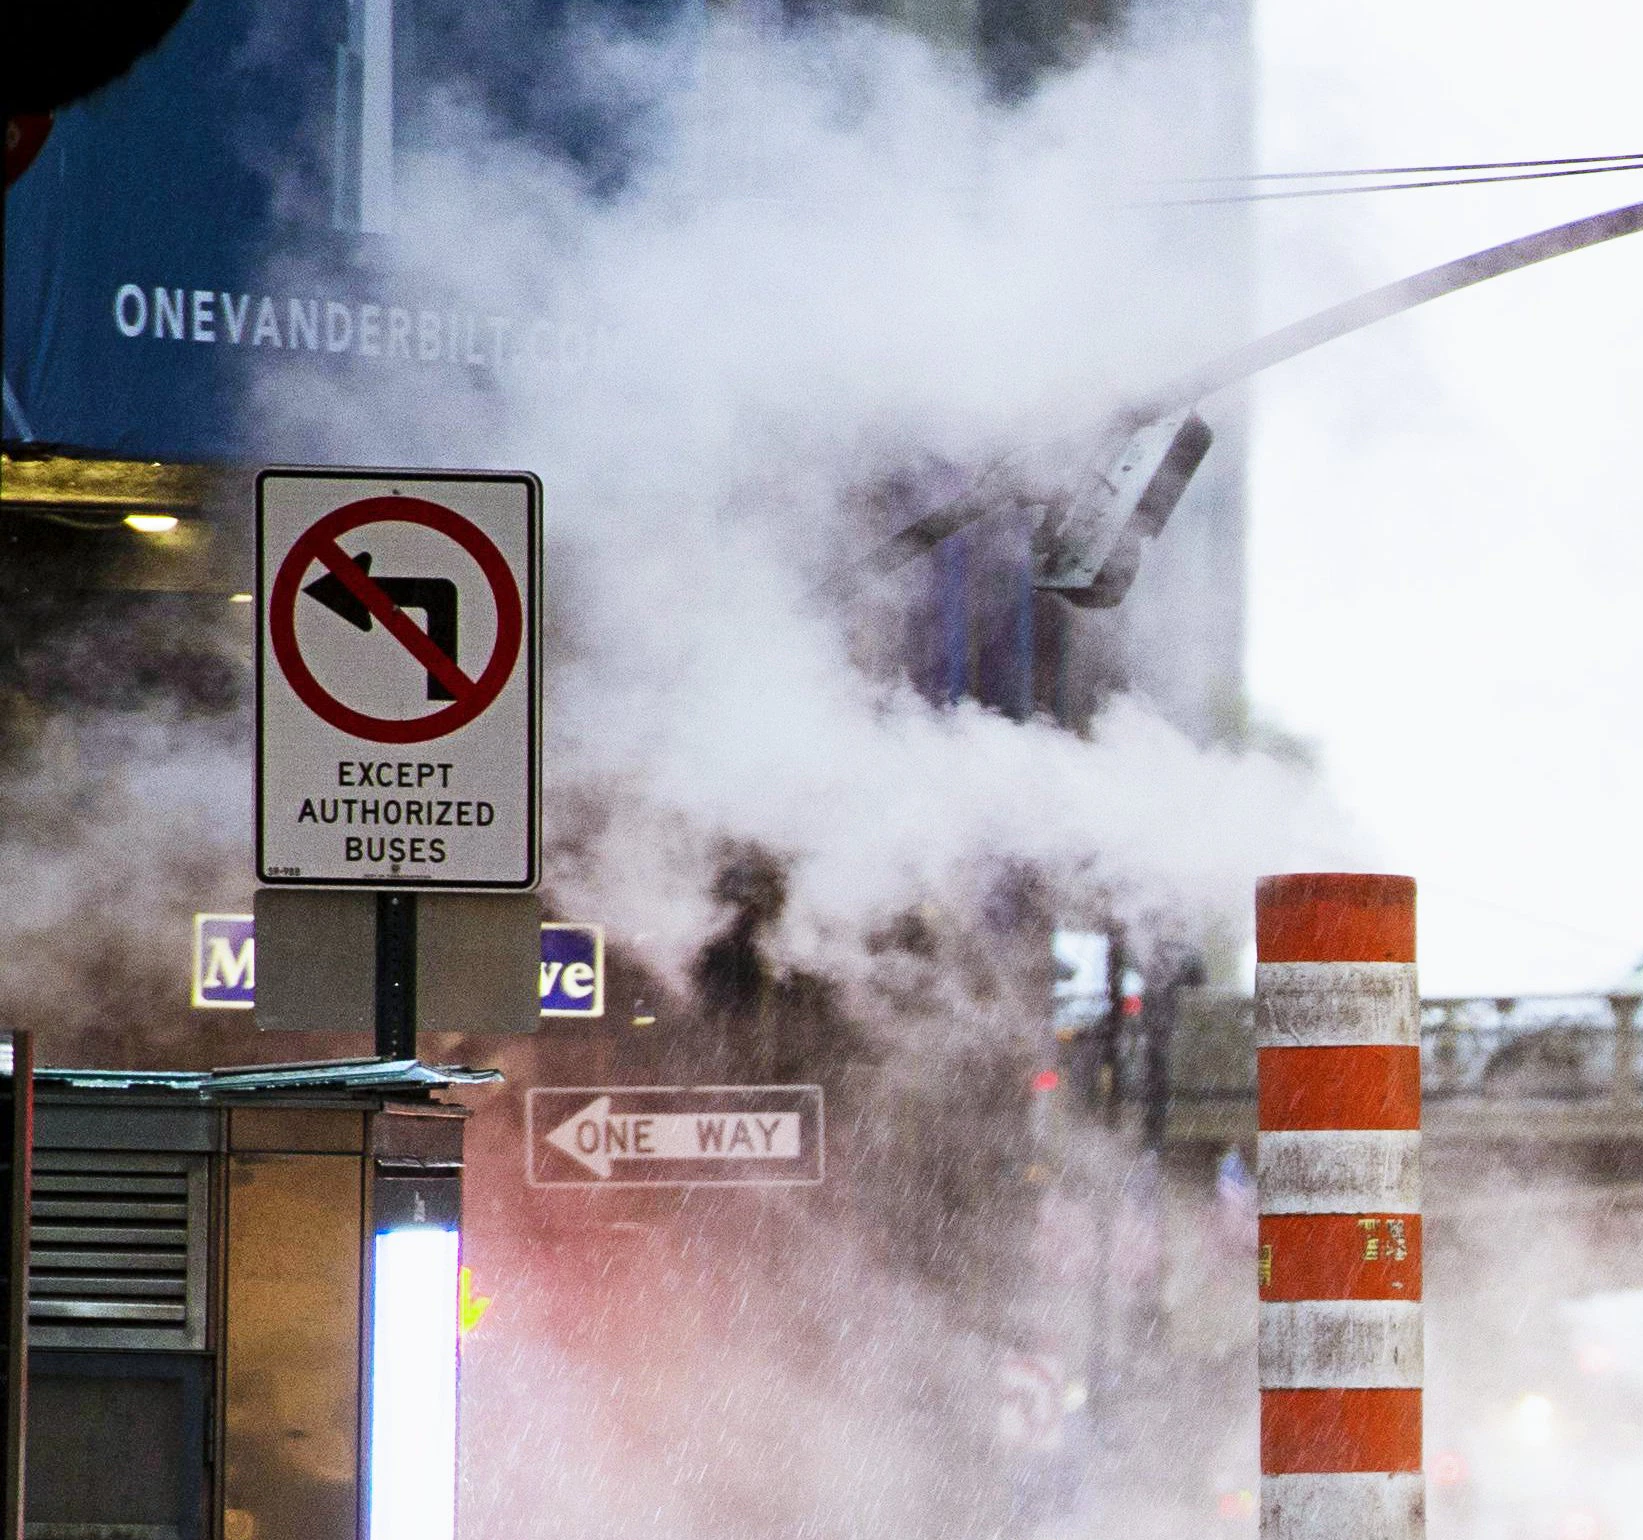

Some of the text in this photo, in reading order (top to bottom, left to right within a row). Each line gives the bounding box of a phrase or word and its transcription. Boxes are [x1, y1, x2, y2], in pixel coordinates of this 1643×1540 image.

[338, 761, 453, 788] EXCEPT
[297, 798, 494, 827] AUTHORIZED
[345, 837, 447, 863] BUSES
[541, 955, 595, 999] ve
[576, 1117, 784, 1154] ONE WAY
